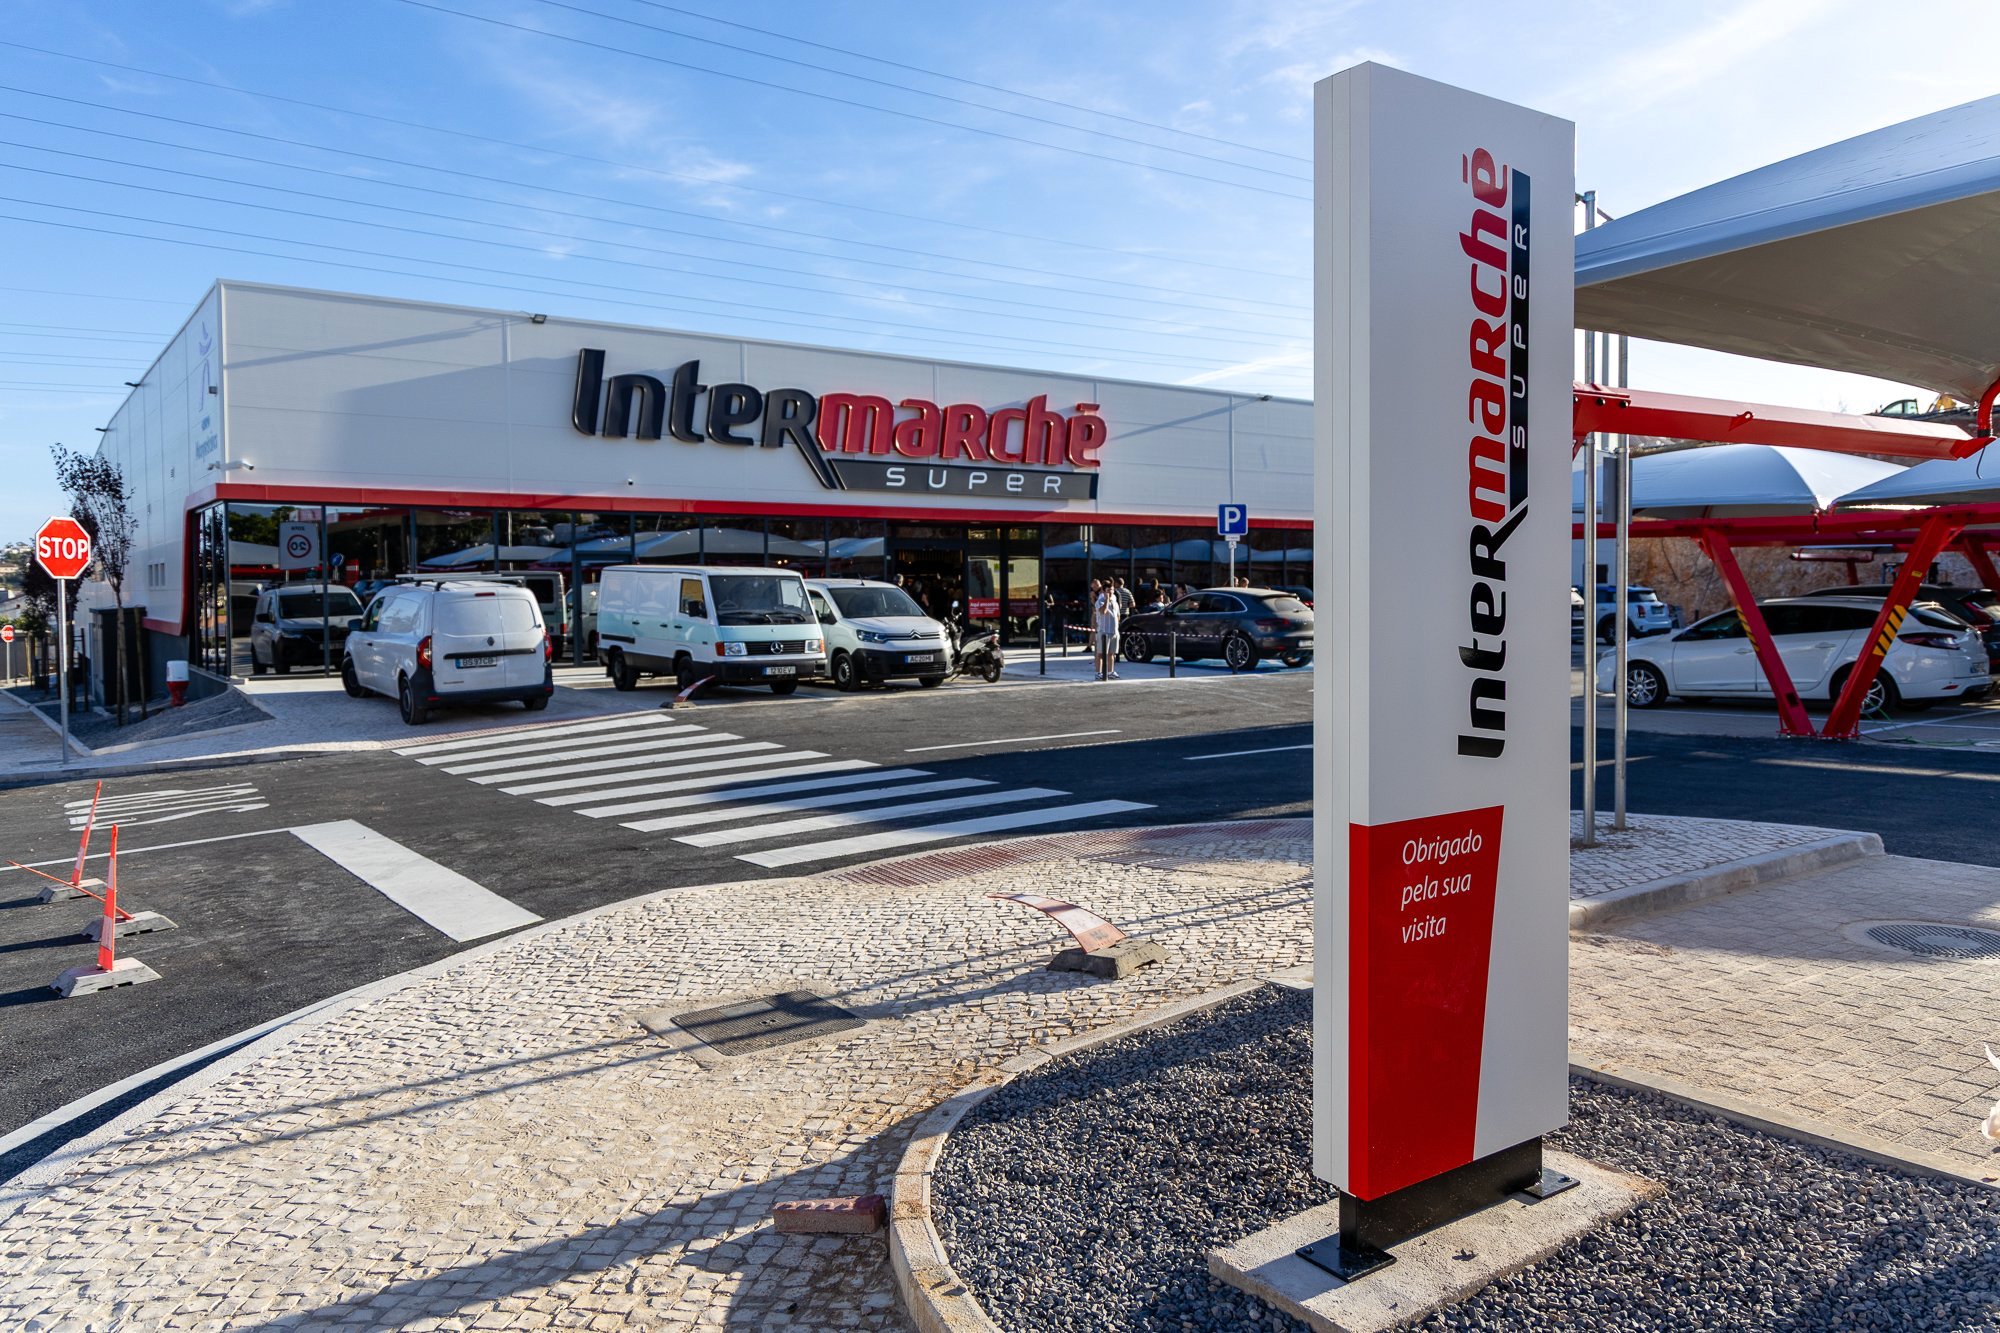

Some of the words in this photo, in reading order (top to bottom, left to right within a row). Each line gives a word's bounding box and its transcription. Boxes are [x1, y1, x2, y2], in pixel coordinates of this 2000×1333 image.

[1225, 507, 1241, 532] P
[39, 537, 88, 560] STOP
[1402, 828, 1482, 865] Obrigado
[1401, 875, 1438, 911] pela
[1442, 874, 1471, 896] sua
[1402, 915, 1447, 944] visita
